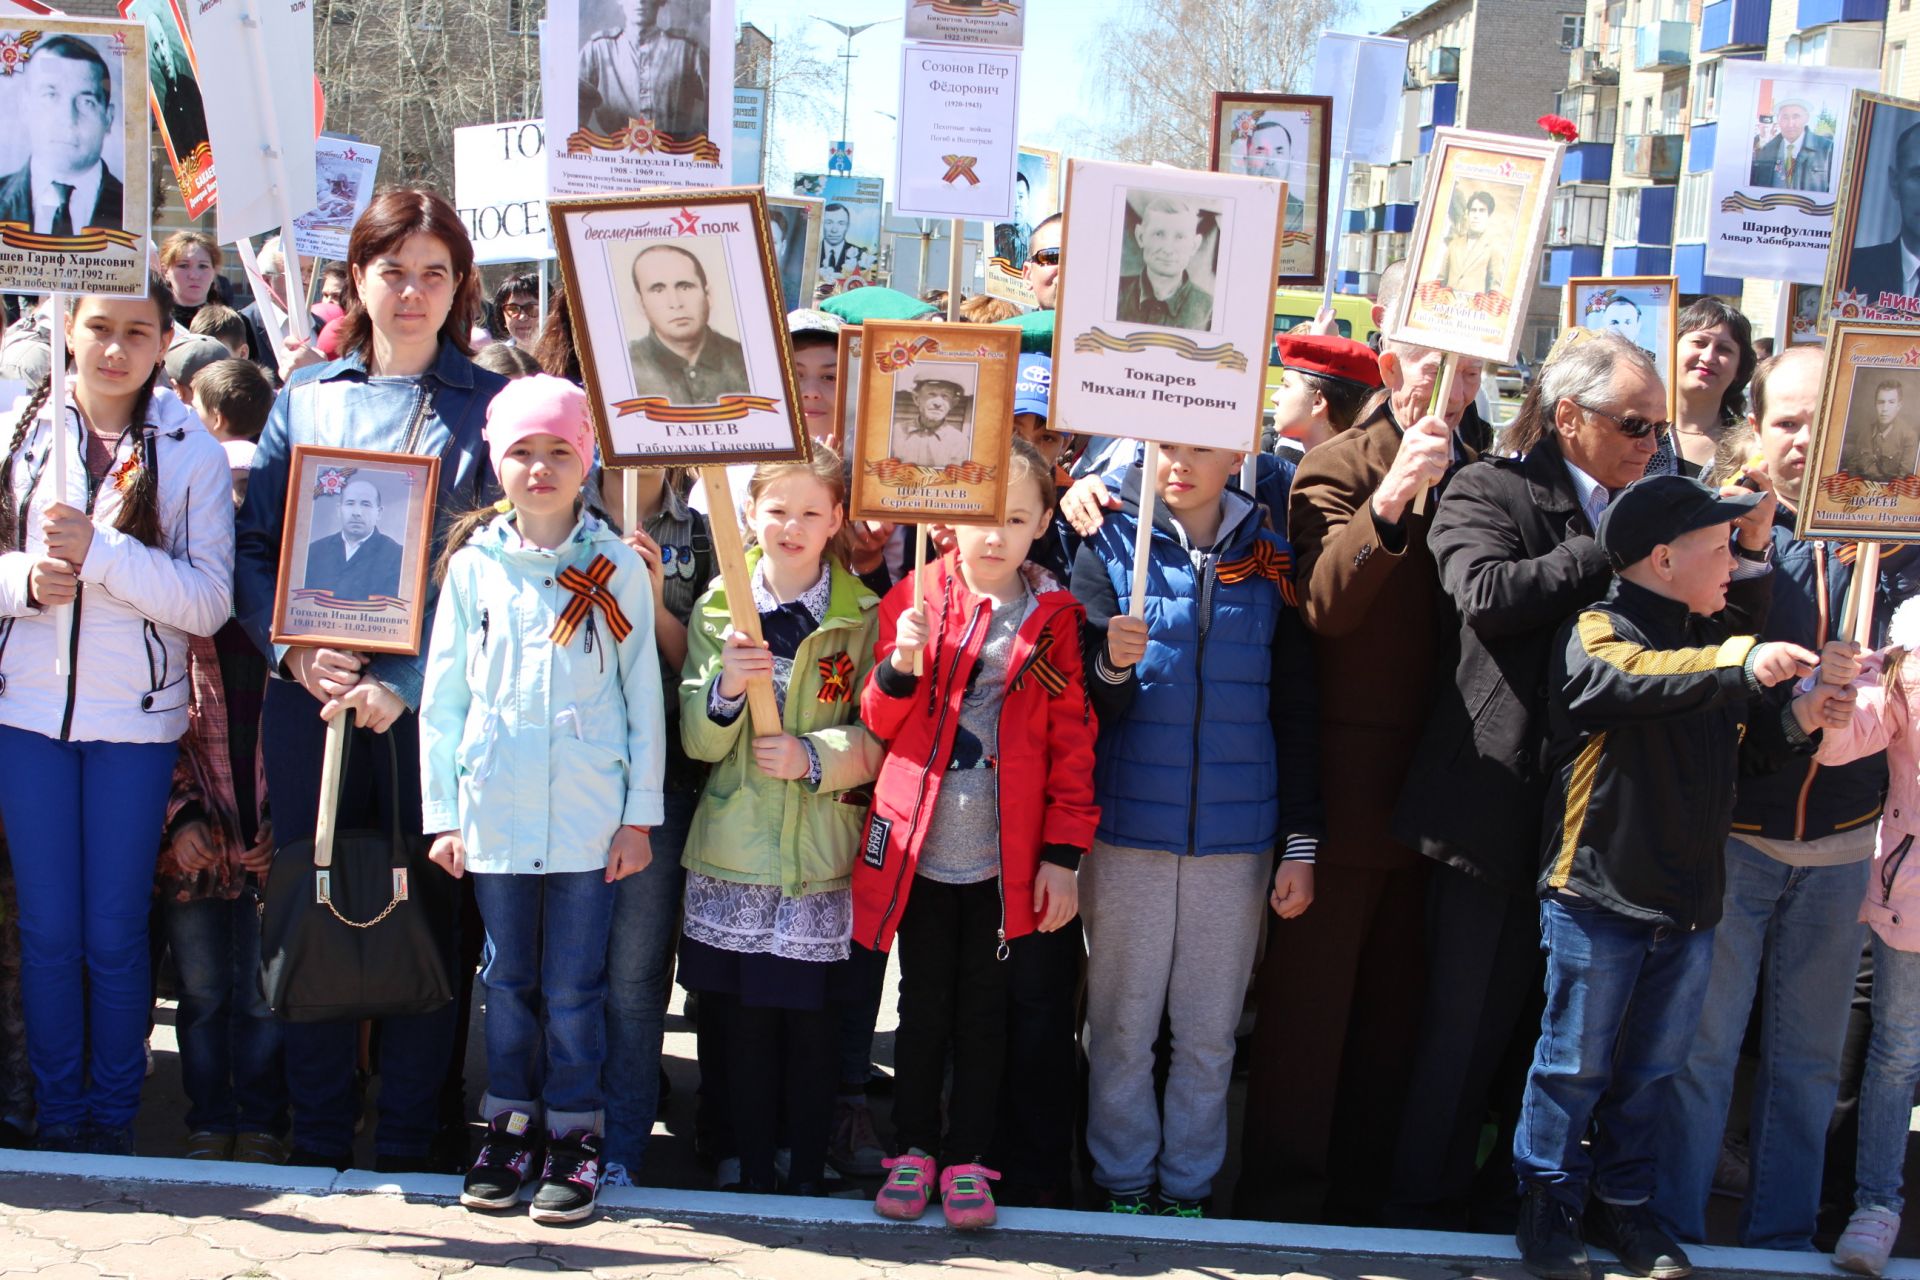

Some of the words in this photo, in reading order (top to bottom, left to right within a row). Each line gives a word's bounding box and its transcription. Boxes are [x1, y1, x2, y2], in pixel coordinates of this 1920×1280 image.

[921, 59, 974, 74] Созонов
[978, 63, 1009, 79] Пётр
[929, 80, 999, 96] Фёдорович
[497, 124, 545, 160] ТО
[609, 166, 628, 175] 1908
[635, 168, 654, 177] 1969
[457, 200, 546, 241] ПОСЕ
[1742, 221, 1832, 238] Шарифуллин
[1720, 232, 1753, 244] Анвар
[0, 251, 24, 261] шев
[27, 251, 65, 266] Гариф
[69, 254, 135, 267] Харисович
[0, 265, 43, 276] 5.07.1924
[54, 268, 102, 280] 17.07.1992
[1124, 367, 1196, 387] Токарев
[1081, 380, 1146, 399] Михаил
[1151, 389, 1236, 411] Петрович
[665, 423, 739, 436] ГАЛЕЕВ
[1850, 496, 1897, 507] НУРЕЕВ
[1878, 512, 1920, 523] Нурееви
[290, 607, 328, 618] Гоголев
[330, 611, 357, 621] Иван
[360, 613, 409, 625] Иванович
